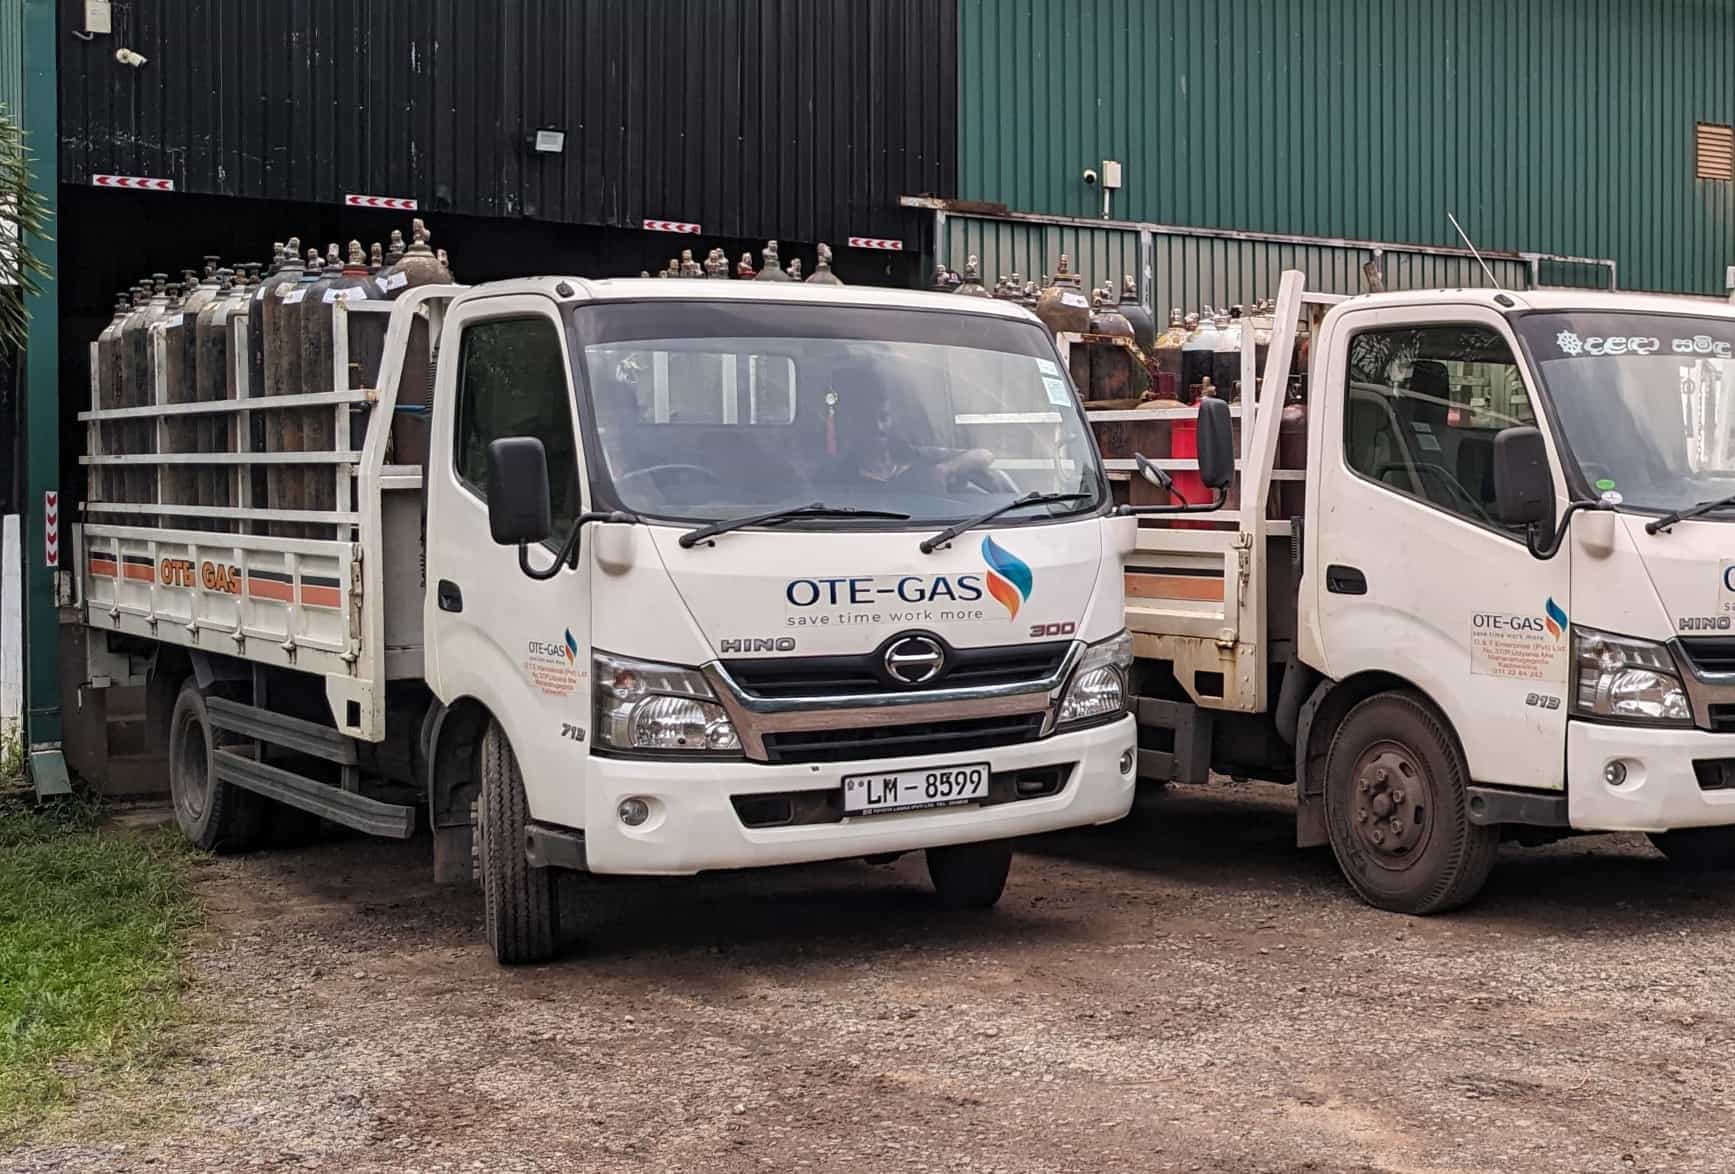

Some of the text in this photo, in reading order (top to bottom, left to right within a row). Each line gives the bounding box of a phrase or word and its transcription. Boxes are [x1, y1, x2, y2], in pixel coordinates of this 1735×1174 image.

[160, 558, 240, 594] OTE GAS
[786, 574, 983, 607] OTE-GAS
[787, 608, 984, 627] save time work more
[1473, 614, 1544, 632] OTE-GAS
[1679, 616, 1731, 631] HINO
[1029, 621, 1076, 637] 300
[528, 641, 565, 658] OTE-GAS
[720, 637, 797, 653] HINO
